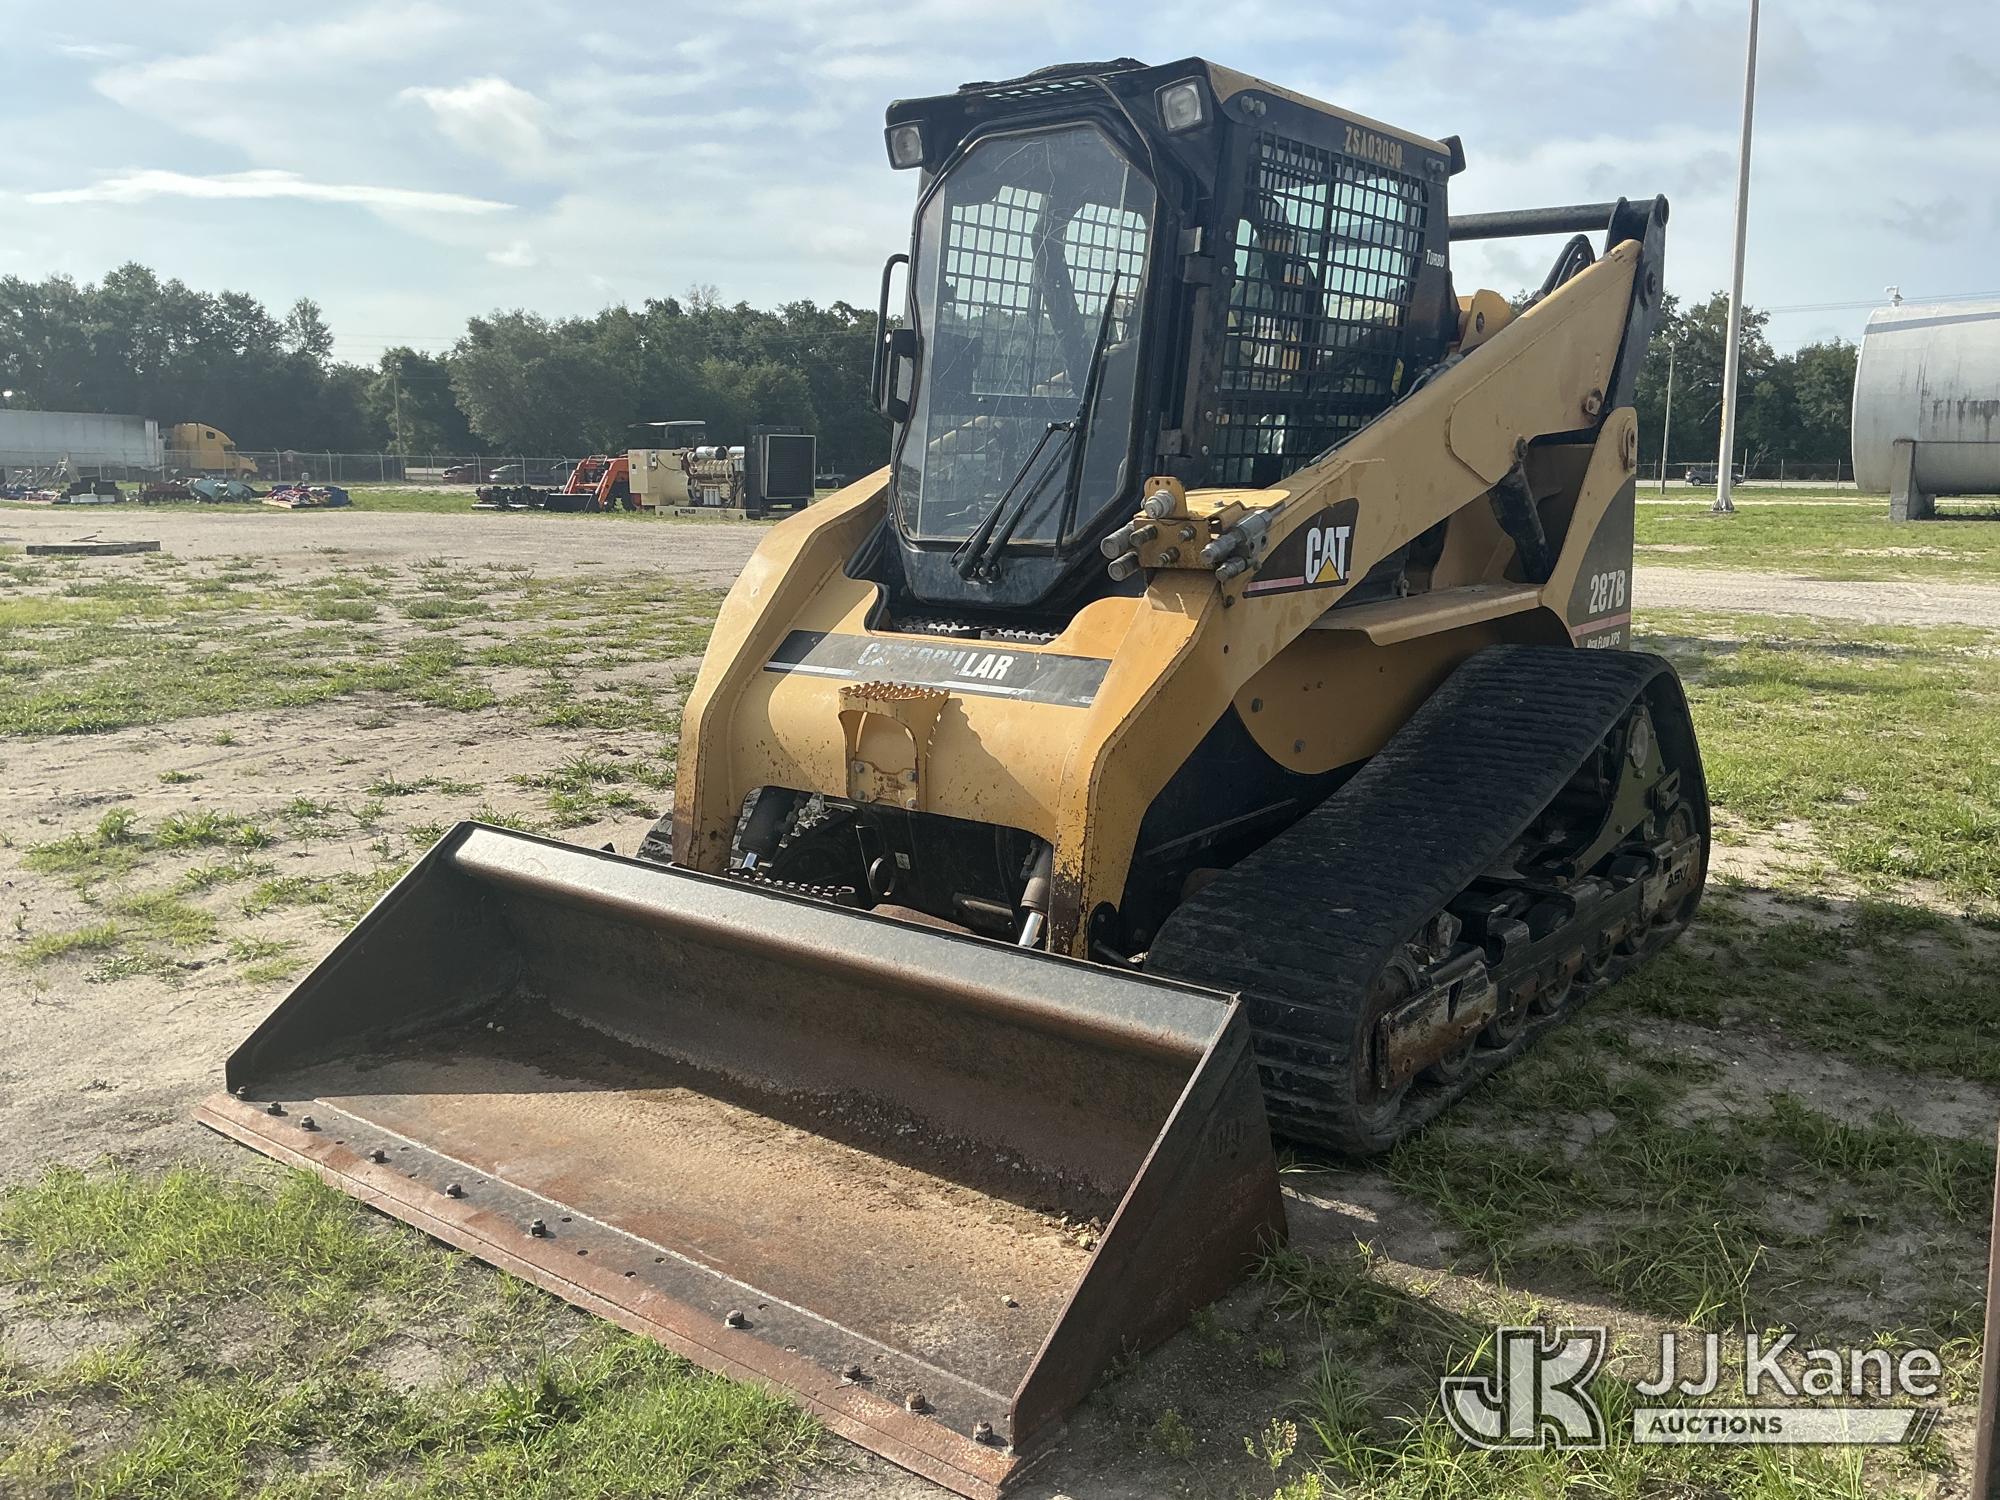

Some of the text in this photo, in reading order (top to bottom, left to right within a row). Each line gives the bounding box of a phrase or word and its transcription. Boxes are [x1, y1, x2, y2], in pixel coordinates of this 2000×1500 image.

[1426, 249, 1445, 267] TURBO
[1306, 526, 1350, 584] CAT
[1589, 570, 1626, 614] 287B
